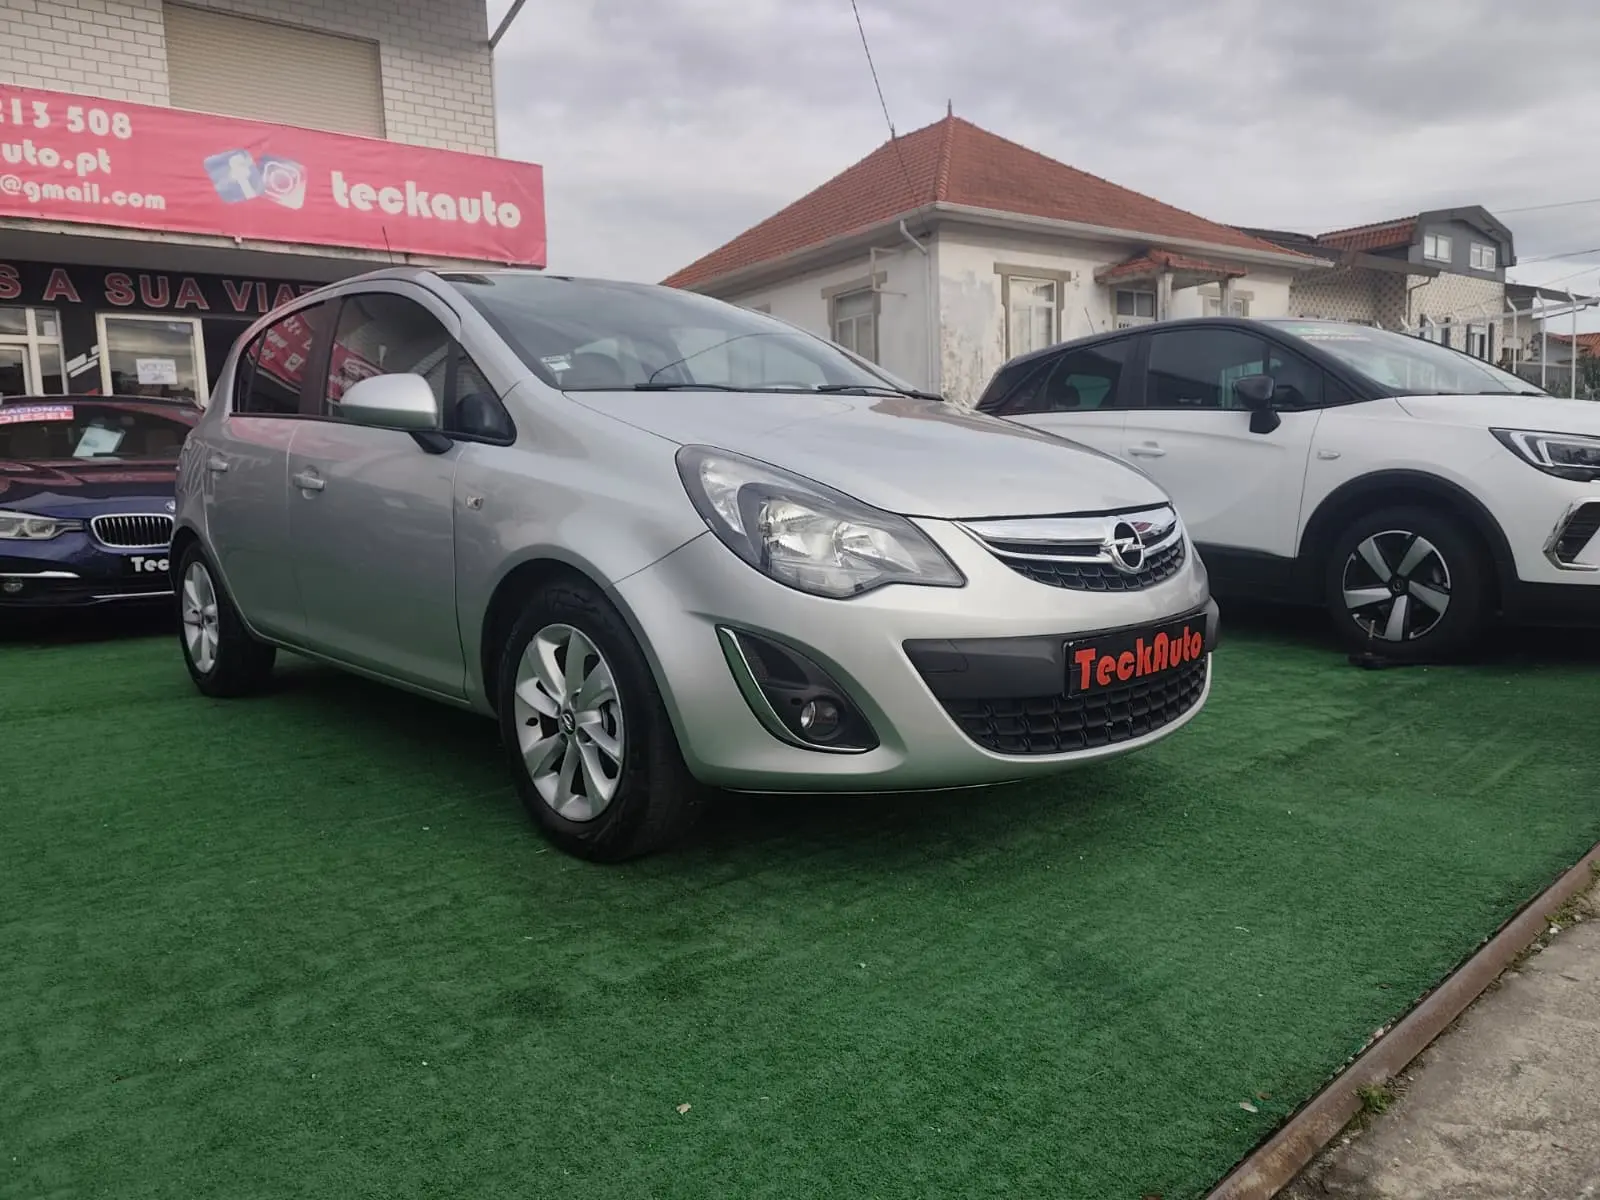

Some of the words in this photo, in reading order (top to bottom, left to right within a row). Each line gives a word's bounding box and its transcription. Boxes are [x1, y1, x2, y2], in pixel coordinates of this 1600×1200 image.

[0, 98, 51, 129] 13
[67, 105, 132, 140] 508
[1, 138, 111, 177] uto.pt
[0, 173, 166, 210] @gmail.com
[331, 170, 521, 228] teckauto
[42, 268, 81, 302] A
[104, 272, 209, 310] SUA
[222, 280, 320, 313] VIA
[0, 412, 74, 425] DIESEL
[130, 556, 170, 573] Tec
[1075, 626, 1203, 690] TeckAuto
